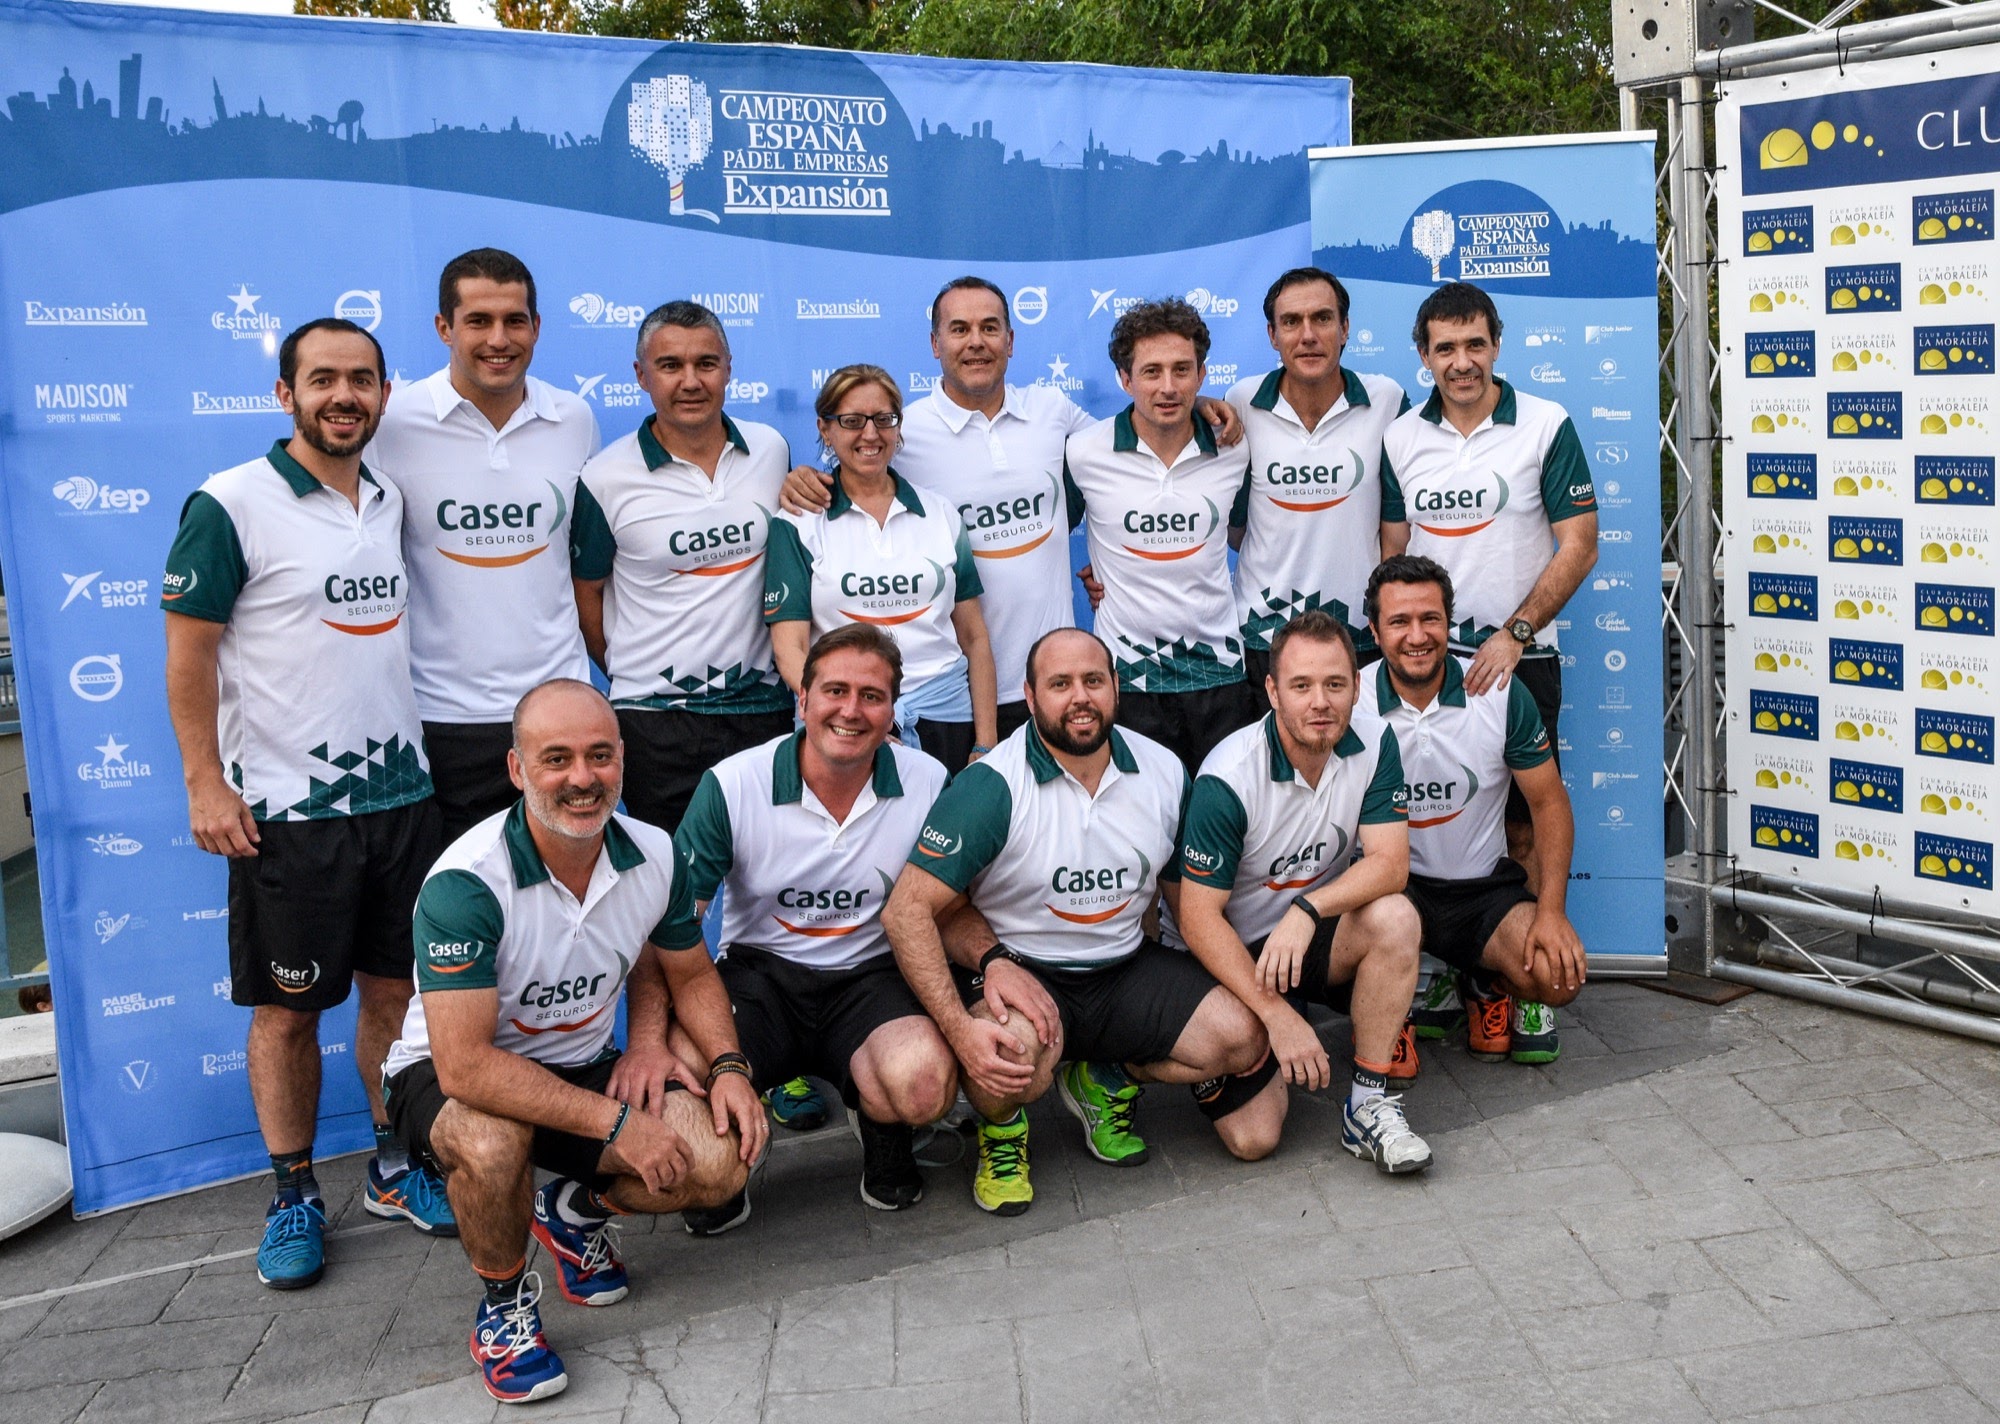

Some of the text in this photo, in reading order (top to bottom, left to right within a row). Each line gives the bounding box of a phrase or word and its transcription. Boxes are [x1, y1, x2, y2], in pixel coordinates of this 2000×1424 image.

[721, 95, 886, 126] CAMPEONATO
[747, 122, 866, 152] ESPAÑA
[722, 149, 889, 173] PÁDEL EMPRESAS
[724, 175, 890, 214] Expansión
[1918, 203, 1988, 216] LA MORALEJA
[1459, 214, 1550, 232] CAMPEONATO
[1748, 219, 1808, 230] LA MORALEJA
[1830, 212, 1894, 223] LA MORALEJA
[1473, 229, 1538, 246] ESPAÑA
[1460, 243, 1550, 257] PÁDEL EMPRESAS
[1460, 257, 1550, 277] Expansión
[1831, 276, 1895, 286] LA MORALEJA
[691, 293, 760, 314] MADISON
[796, 299, 881, 319] Expansión
[1210, 295, 1239, 317] fep
[25, 301, 147, 324] Expansión
[605, 301, 646, 328] fep
[211, 311, 281, 331] Estrella
[723, 318, 755, 328] MARKETING
[232, 330, 263, 340] Damm
[1919, 337, 1988, 347] LA MORALEJA
[1764, 343, 1810, 351] MORALEJA
[1207, 364, 1238, 375] DROP
[1208, 375, 1238, 385] SHOT
[35, 383, 128, 409] MADISON
[602, 383, 641, 395] DROP
[730, 377, 769, 403] fep
[192, 391, 283, 414] Expansi
[603, 395, 641, 408] SHOT
[1847, 404, 1896, 412] MORALEJA
[1935, 403, 1988, 412] MORALEJA
[46, 412, 122, 424] SPORTS MARKETING
[1267, 462, 1344, 485] Caser
[1752, 464, 1811, 473] LA MORALEJA
[1935, 469, 1989, 477] MORALEJA
[1285, 488, 1338, 496] SEGUROS
[1569, 483, 1593, 497] Case
[99, 484, 150, 514] fep
[1414, 488, 1487, 511] Caser
[436, 499, 542, 531] Caser
[1123, 510, 1200, 534] Caser
[1432, 512, 1483, 521] SEGUROS
[669, 520, 755, 556] Caser
[983, 521, 1044, 542] SEGUROS
[1834, 528, 1897, 538] LA MORALEJA
[465, 534, 535, 546] SEGUROS
[1143, 536, 1195, 544] SEGUROS
[694, 546, 751, 563] SEGUROS
[100, 580, 148, 594] DROP
[324, 574, 400, 603] Caser
[841, 572, 924, 597] Caser
[1767, 585, 1812, 595] MORALEJA
[101, 594, 147, 608] SHOT
[862, 599, 918, 608] SEGUROS
[1921, 595, 1989, 608] LA MORALEJA
[347, 603, 396, 616] SEGUROS
[1767, 644, 1813, 655] MORALEJA
[1849, 651, 1898, 663] MORALEJA
[78, 674, 116, 682] VOLVO
[1768, 702, 1814, 715] MORALEJA
[1921, 720, 1988, 736] LA MORALEJA
[77, 760, 151, 781] Estrella
[1835, 769, 1898, 786] LA MORALEJA
[100, 779, 132, 790] Damm
[1408, 804, 1452, 813] EGUROS
[1769, 818, 1814, 832] MORALEJA
[923, 825, 952, 848] Caser
[111, 841, 140, 852] Hero
[1920, 843, 1987, 862] LA MORALEJA
[1184, 844, 1214, 866] Caser
[1052, 866, 1128, 893] Caser
[777, 887, 869, 910] Caser
[1070, 894, 1122, 905] SEGUROS
[183, 908, 230, 921] HEA
[798, 911, 860, 921] SEGUROS
[428, 942, 471, 957] Caser
[271, 960, 309, 981] Caser
[519, 972, 606, 1008] Caser
[102, 992, 146, 1008] PADEL
[104, 996, 175, 1017] ABSOLUTE
[536, 1002, 594, 1021] SEGUROS
[1355, 1071, 1383, 1089] Caser
